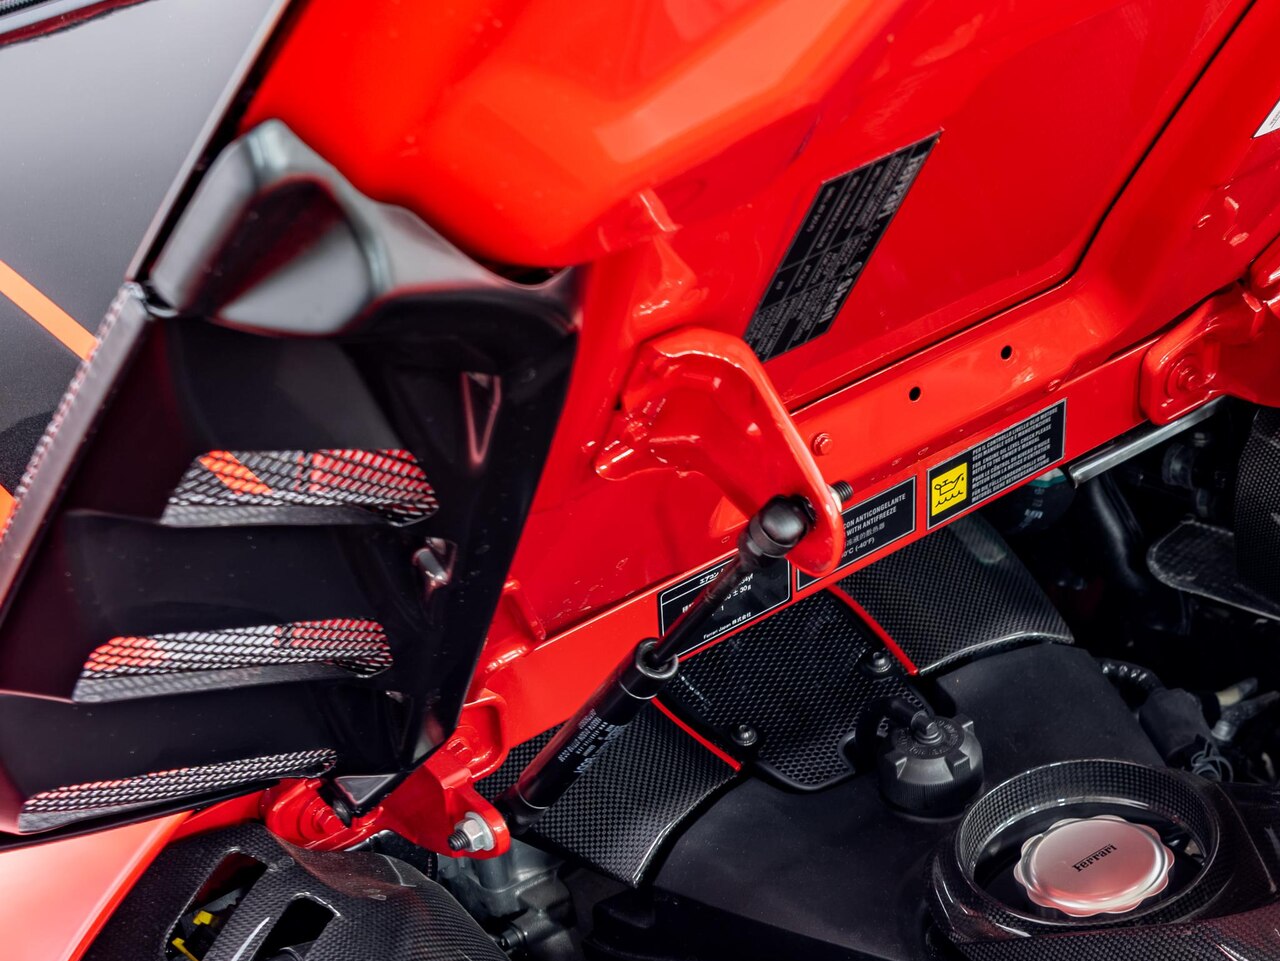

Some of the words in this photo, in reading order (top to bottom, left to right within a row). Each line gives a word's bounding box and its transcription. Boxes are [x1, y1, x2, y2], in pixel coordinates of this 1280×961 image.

[818, 278, 853, 323] Shell
[972, 460, 981, 469] FOR
[983, 451, 999, 464] ENGINE
[1007, 440, 1020, 450] LEVEL
[1020, 432, 1034, 444] CHECK
[1036, 424, 1051, 436] PLEASE
[972, 464, 986, 476] REFER
[993, 456, 1001, 464] THE
[1022, 436, 1040, 450] MANUAL
[983, 441, 1004, 456] MANUALE
[972, 472, 984, 482] POUR
[1008, 459, 1023, 470] NOTICE
[846, 526, 862, 536] WITH
[862, 506, 897, 528] ANTIFREEZE
[856, 493, 906, 524] ANTICONGELANTE
[1072, 844, 1117, 872] Ferrari
